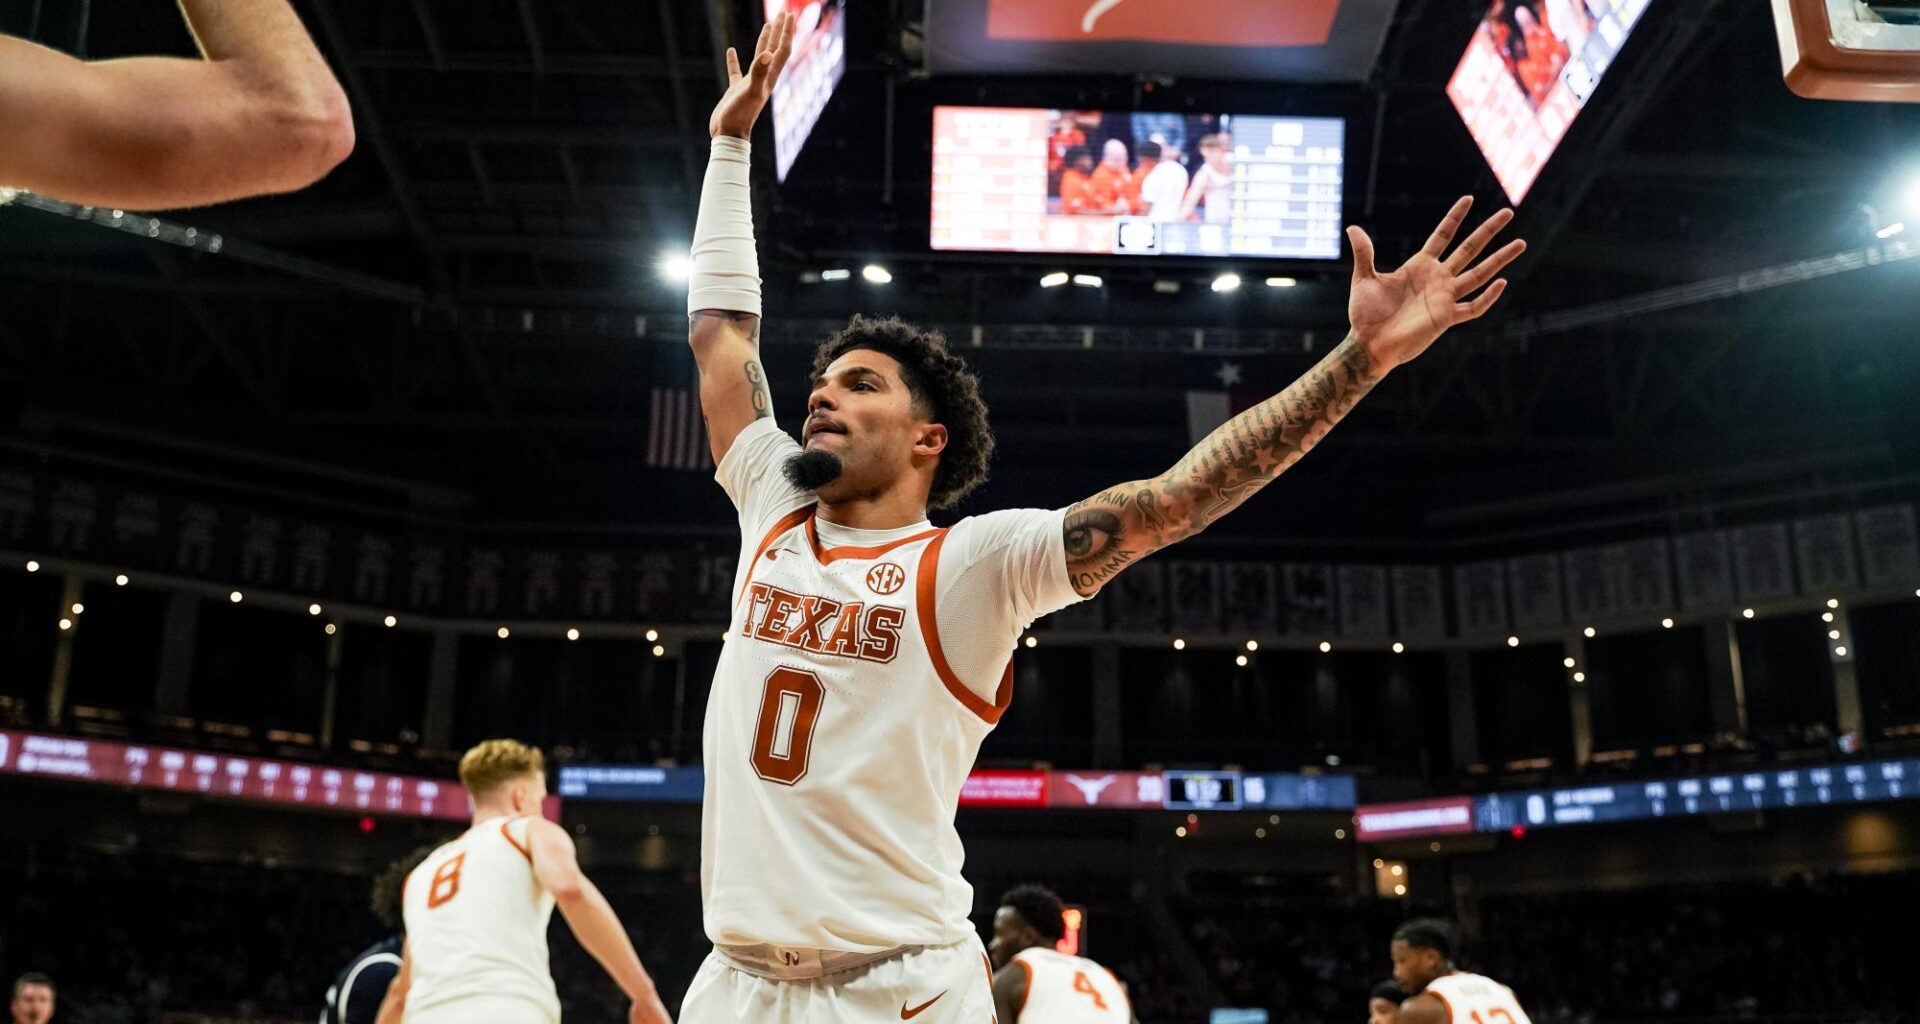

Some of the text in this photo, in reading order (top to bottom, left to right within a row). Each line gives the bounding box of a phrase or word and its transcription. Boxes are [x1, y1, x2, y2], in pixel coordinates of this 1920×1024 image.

[1096, 491, 1129, 507] PAIN
[867, 562, 906, 595] SEC
[742, 582, 906, 664] TEXAS
[750, 665, 826, 786] 0
[427, 852, 465, 909] 8
[1073, 970, 1107, 1009] 4
